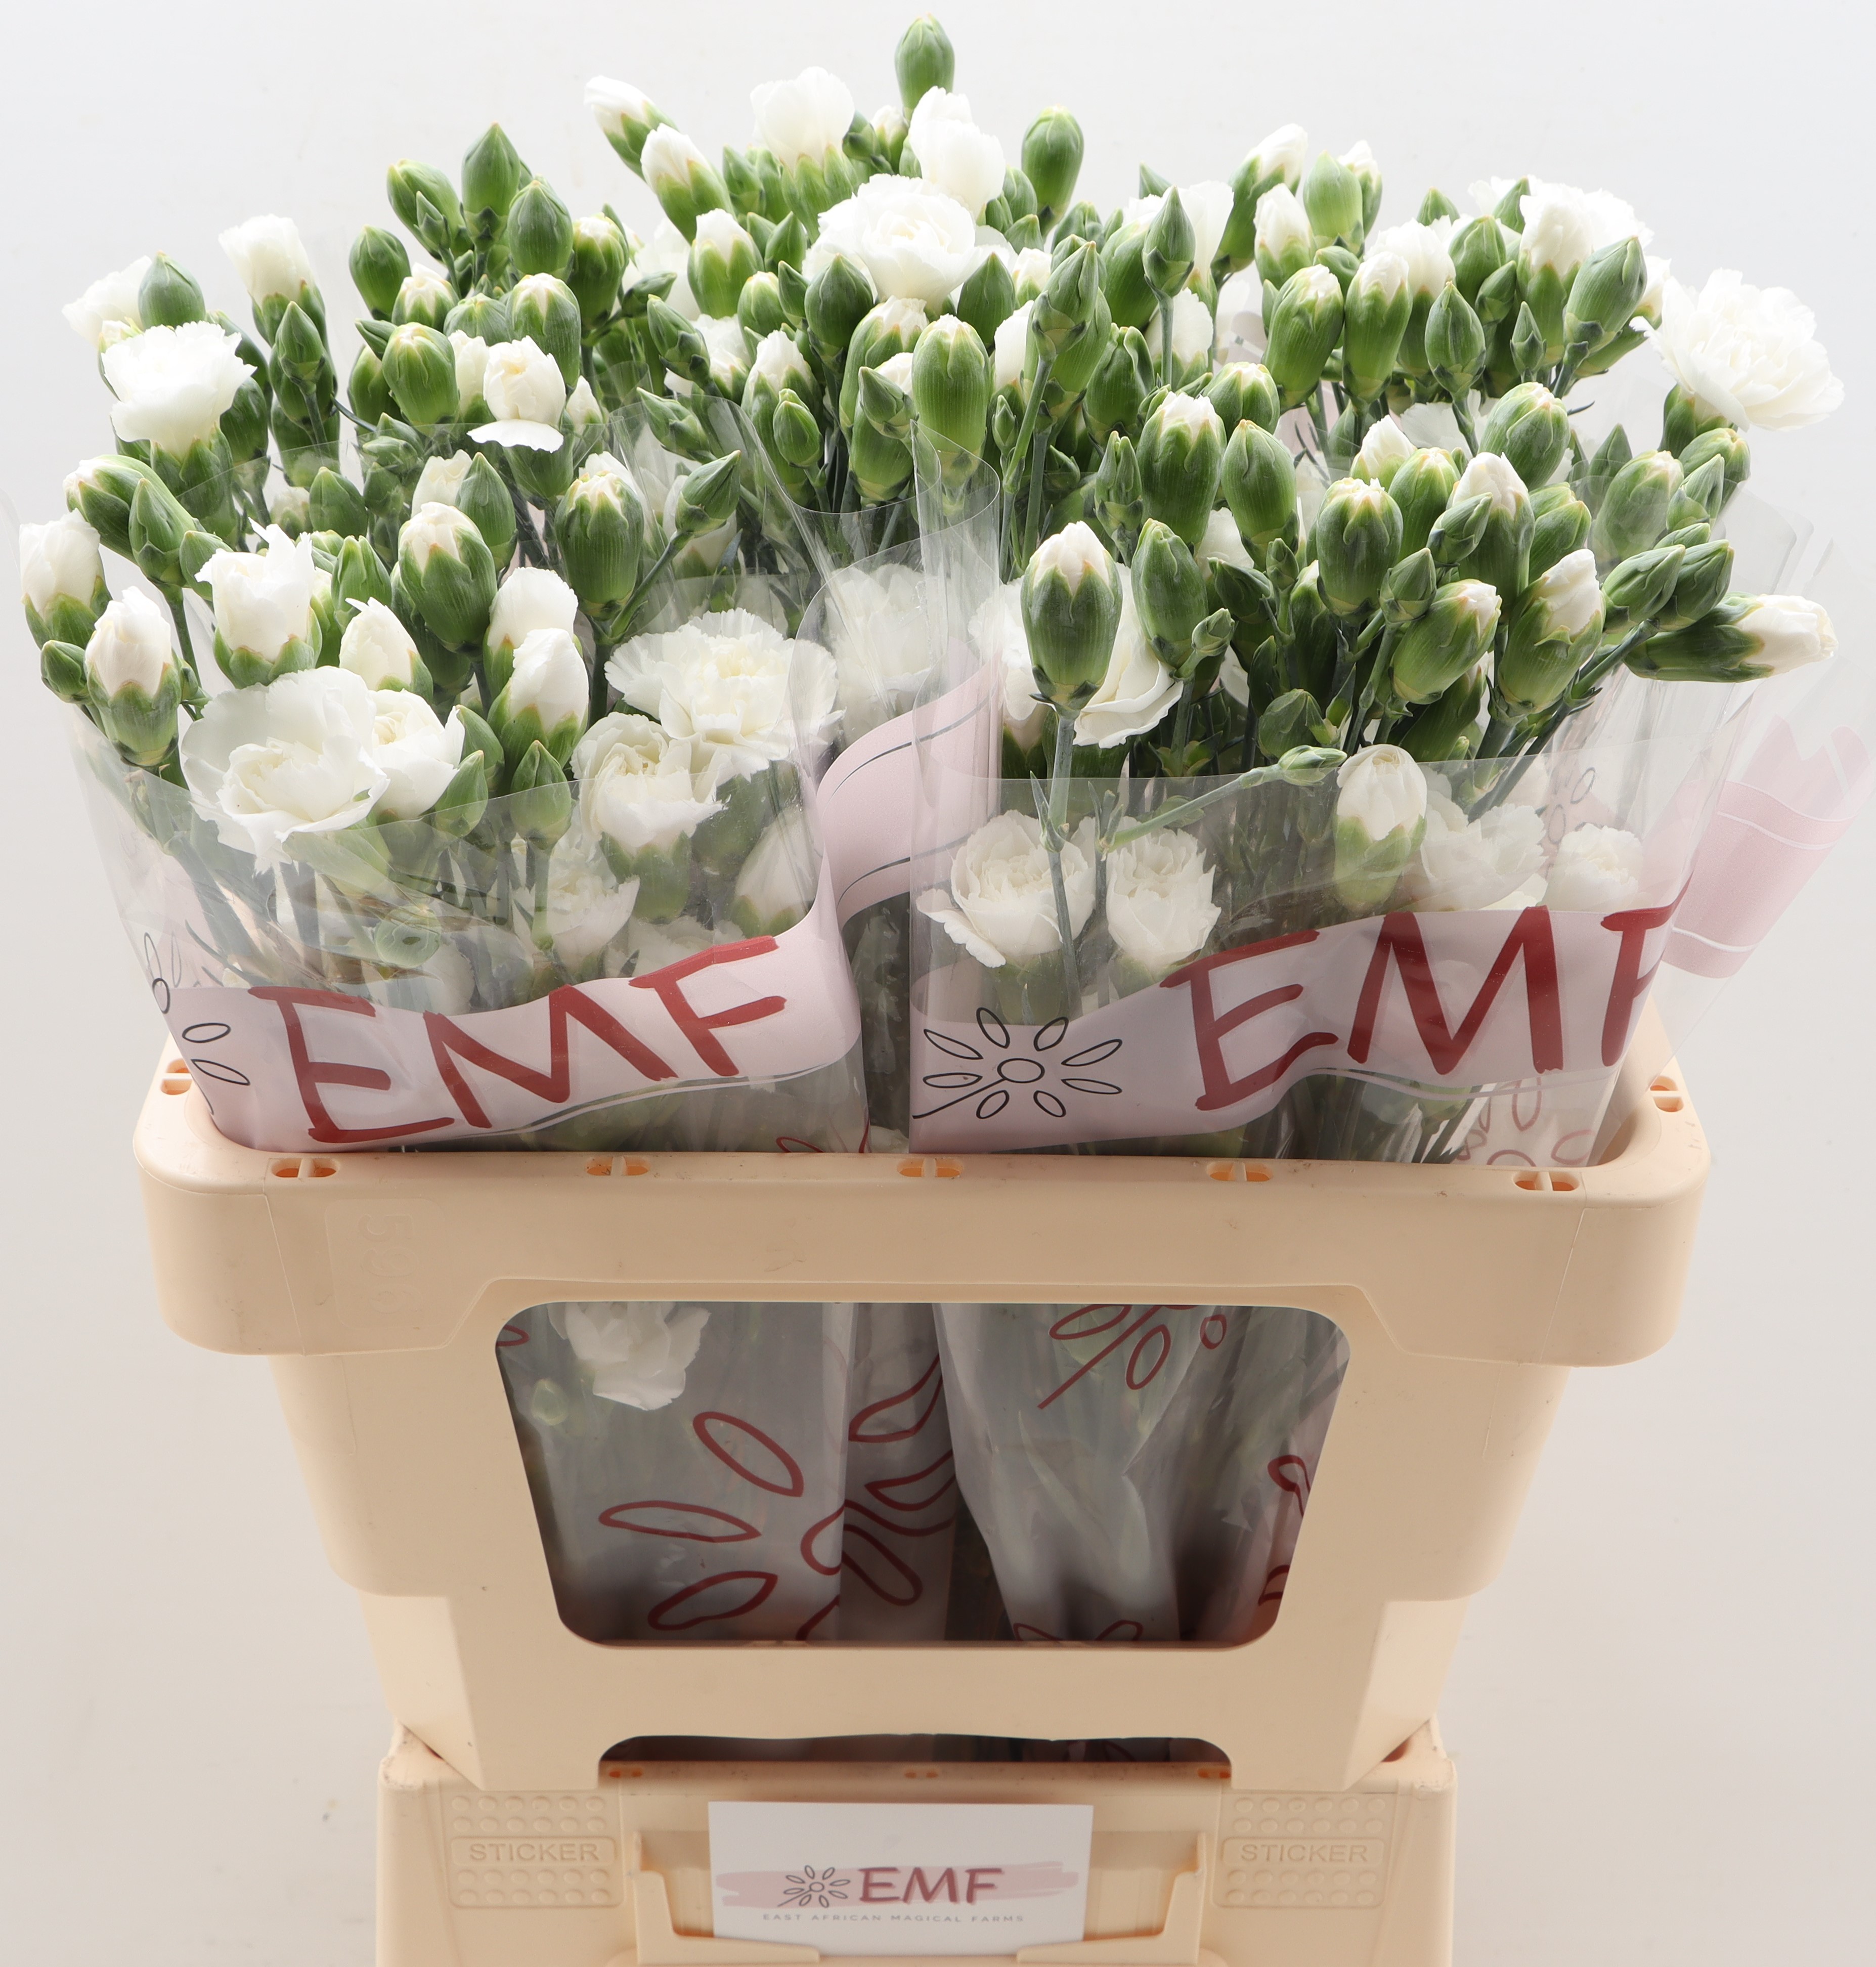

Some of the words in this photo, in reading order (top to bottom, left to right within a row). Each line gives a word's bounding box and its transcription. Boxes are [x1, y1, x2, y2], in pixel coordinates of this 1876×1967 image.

[1159, 872, 1693, 1110] EMF
[247, 934, 788, 1144] EMF
[469, 1843, 599, 1862] STICKER
[1241, 1844, 1368, 1863] STICKER
[857, 1866, 1005, 1905] EMF
[811, 1914, 882, 1922] AFRICAN
[890, 1914, 962, 1922] MAGICAL
[972, 1914, 1024, 1922] FARMS
